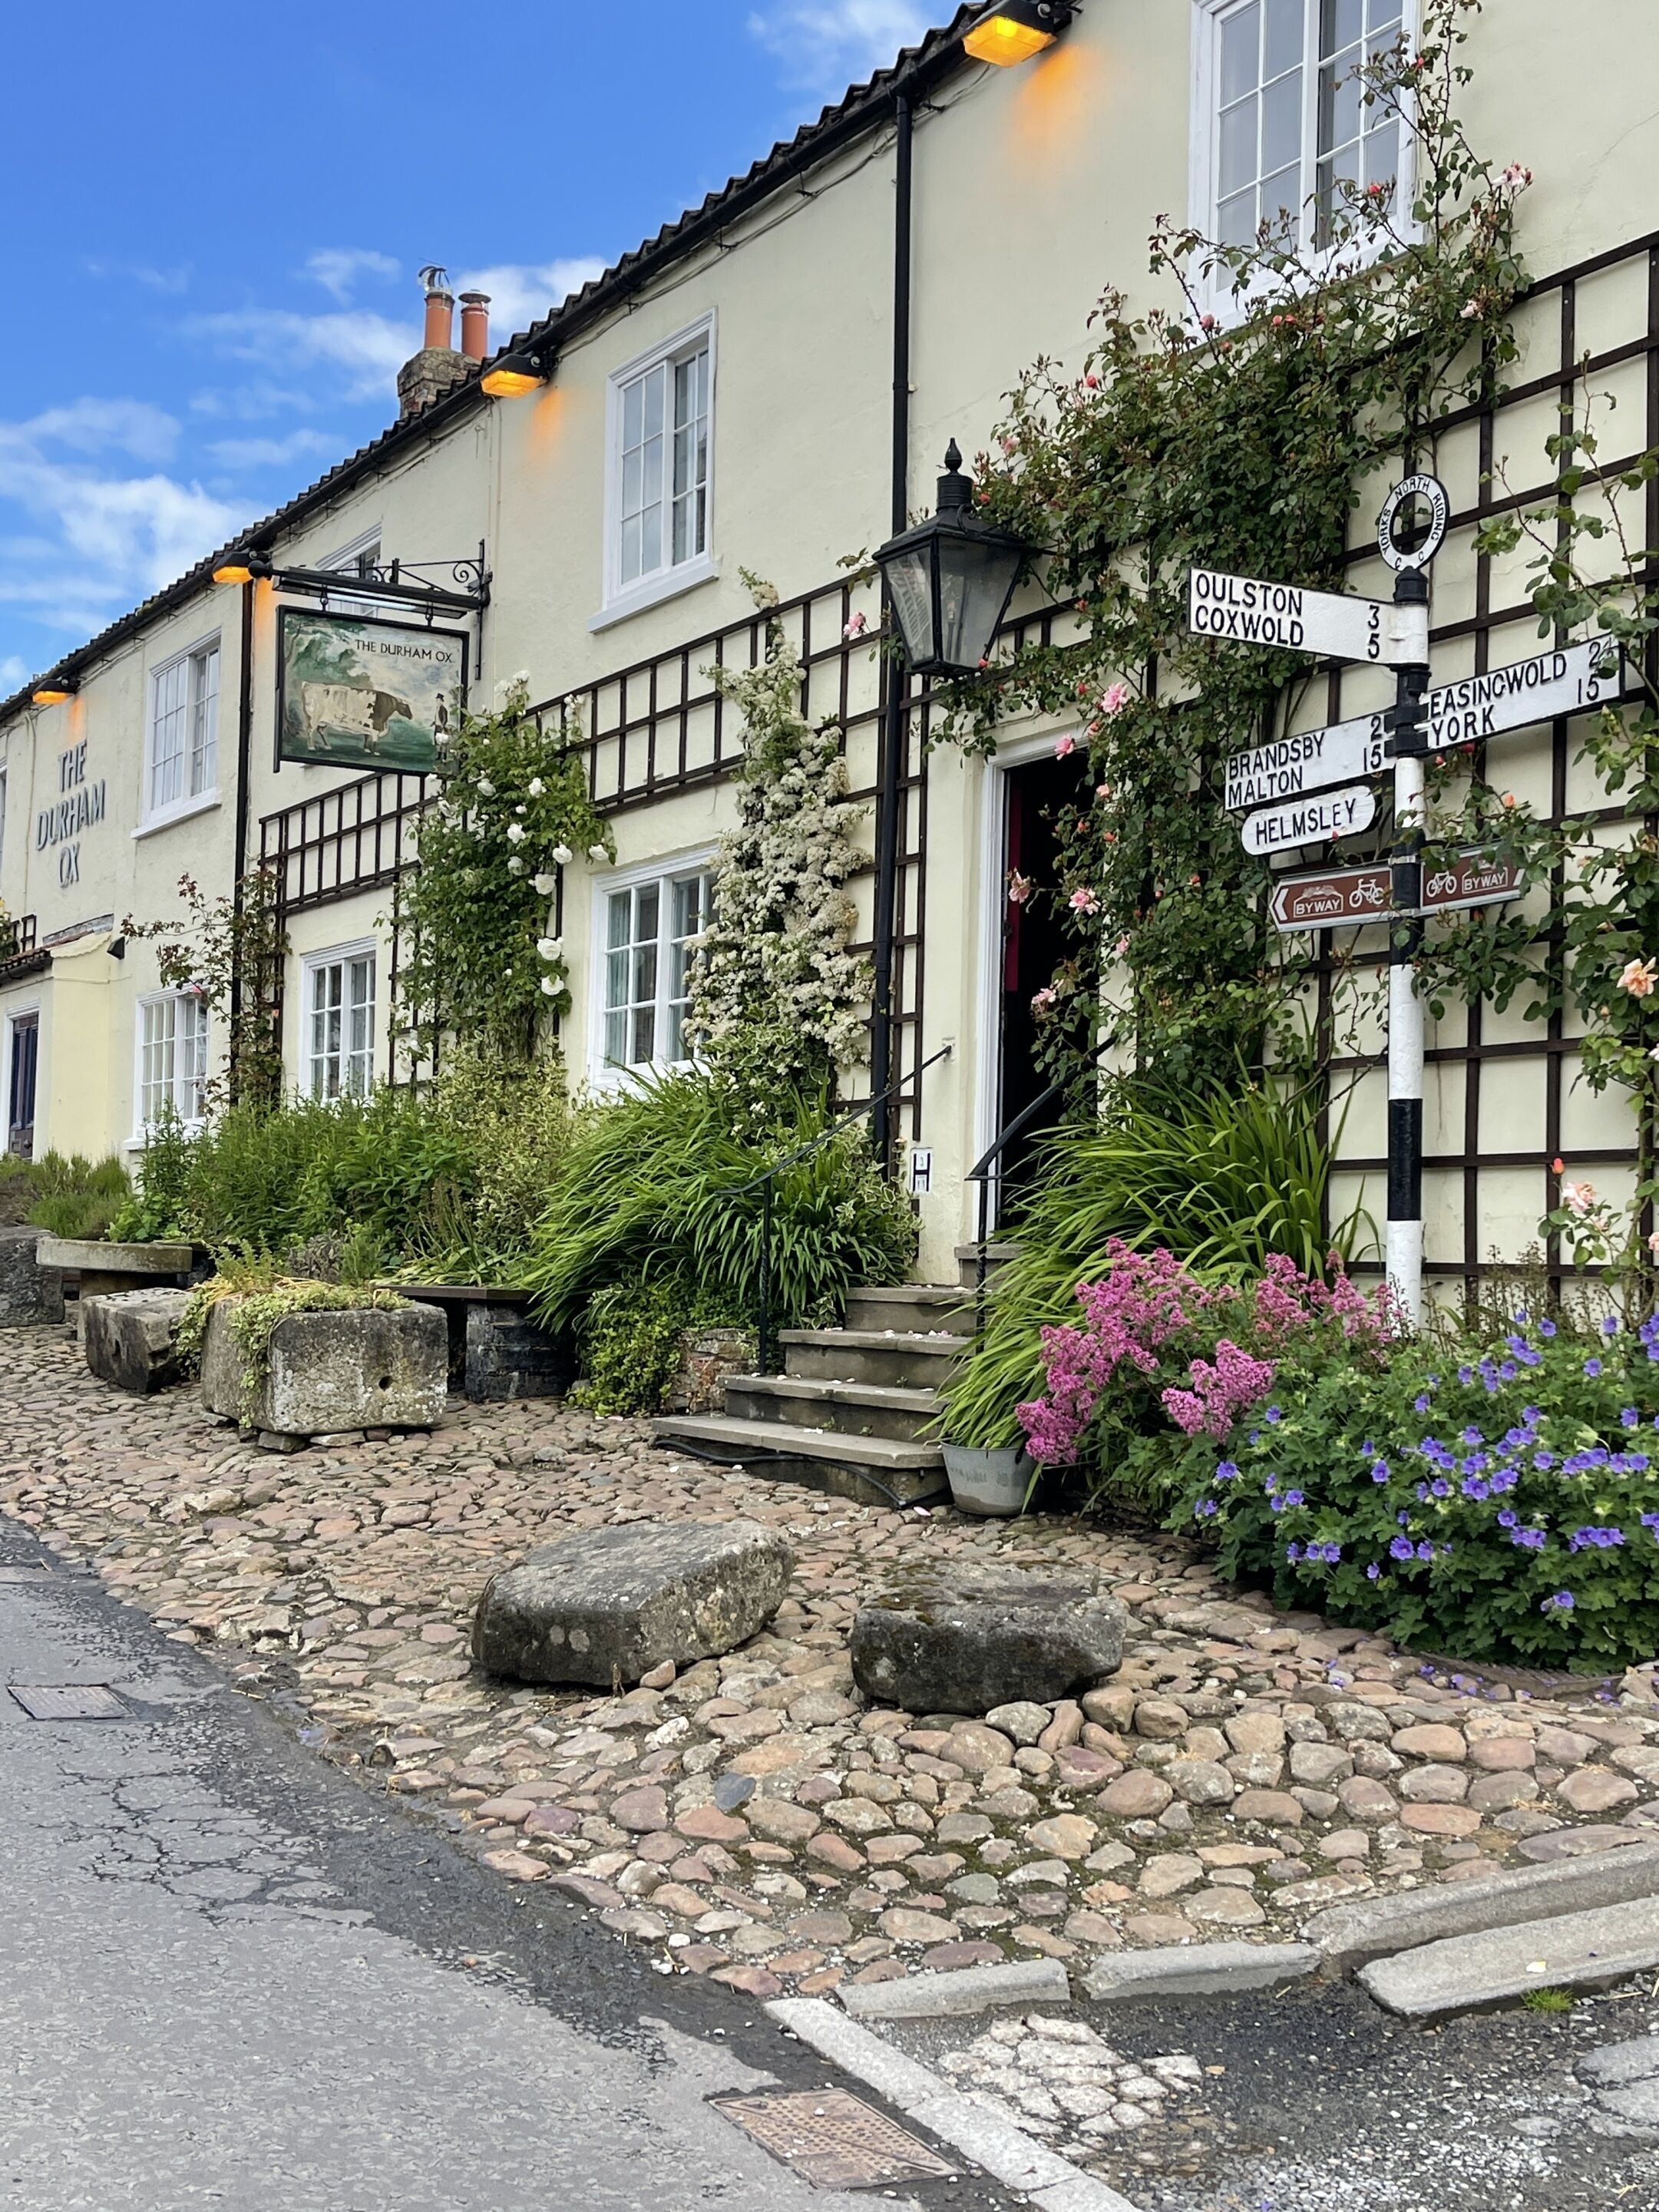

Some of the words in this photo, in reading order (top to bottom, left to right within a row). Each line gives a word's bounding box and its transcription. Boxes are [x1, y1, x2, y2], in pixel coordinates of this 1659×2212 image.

[1380, 508, 1391, 555] YORKS
[1394, 477, 1431, 501] NORTH
[1432, 493, 1445, 541] RIDING
[1395, 557, 1402, 568] C
[1418, 551, 1425, 561] C
[1196, 573, 1303, 617] OULSTON
[1367, 605, 1380, 630] 3
[355, 639, 376, 652] THE
[381, 643, 432, 660] DURHAM
[435, 651, 453, 663] OX
[1195, 605, 1304, 646] COXWOLD
[1367, 633, 1380, 659] 5
[1431, 653, 1567, 718] EASINGWOLD
[1431, 704, 1495, 746] YORK
[1578, 673, 1599, 704] 15
[58, 739, 87, 792] THE
[1229, 732, 1325, 780] BRANDSBY
[1370, 716, 1383, 742] 2
[1228, 765, 1303, 807] MALTON
[1363, 744, 1383, 772] 15
[36, 779, 106, 851] DURHAM
[1256, 799, 1356, 845] HELMSLEY
[59, 841, 80, 888] OX
[1464, 871, 1505, 891] BYWAY
[1296, 899, 1340, 914] BYWAY
